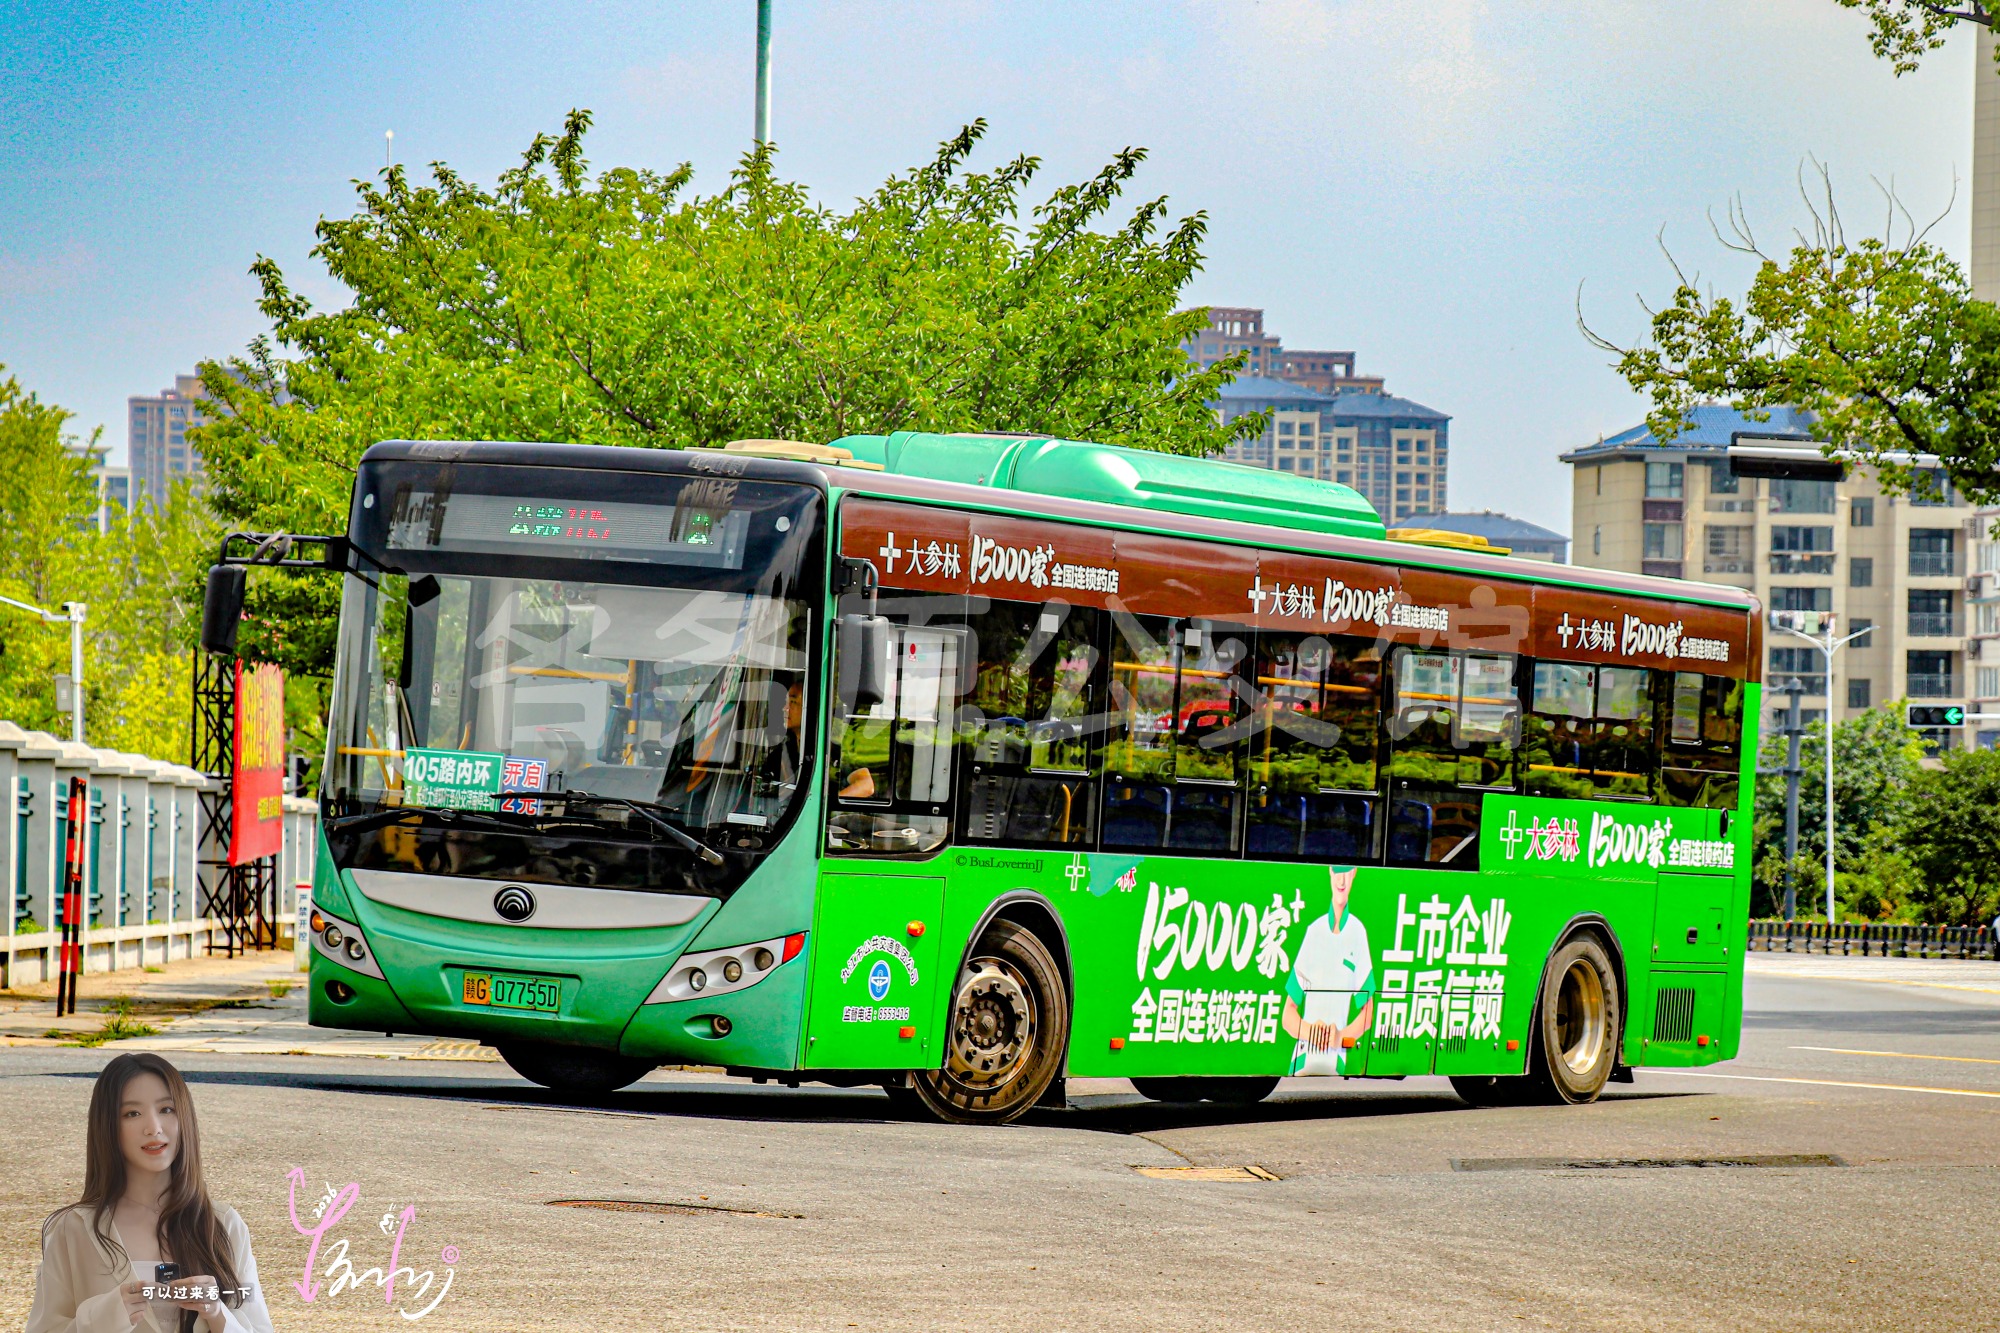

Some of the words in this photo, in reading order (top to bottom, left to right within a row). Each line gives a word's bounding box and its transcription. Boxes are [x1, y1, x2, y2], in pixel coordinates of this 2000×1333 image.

[905, 539, 961, 579] 大参林
[1051, 562, 1120, 594] 全国连锁药店
[1269, 583, 1316, 619] 大参林
[1391, 603, 1449, 631] 全国连锁药店
[1576, 619, 1616, 653] 大参林
[1680, 636, 1730, 662] 全国连锁药店
[404, 755, 492, 787] 105路内环
[503, 762, 543, 788] 开启
[501, 790, 537, 816] 2元
[1524, 816, 1580, 861] 大参林
[1668, 837, 1735, 868] 全国连锁药店
[1382, 893, 1512, 967] 上市企业
[841, 935, 919, 986] 九江市公共交通集团公司
[1129, 987, 1282, 1044] 全国连锁药店
[1374, 968, 1504, 1040] 品质信赖
